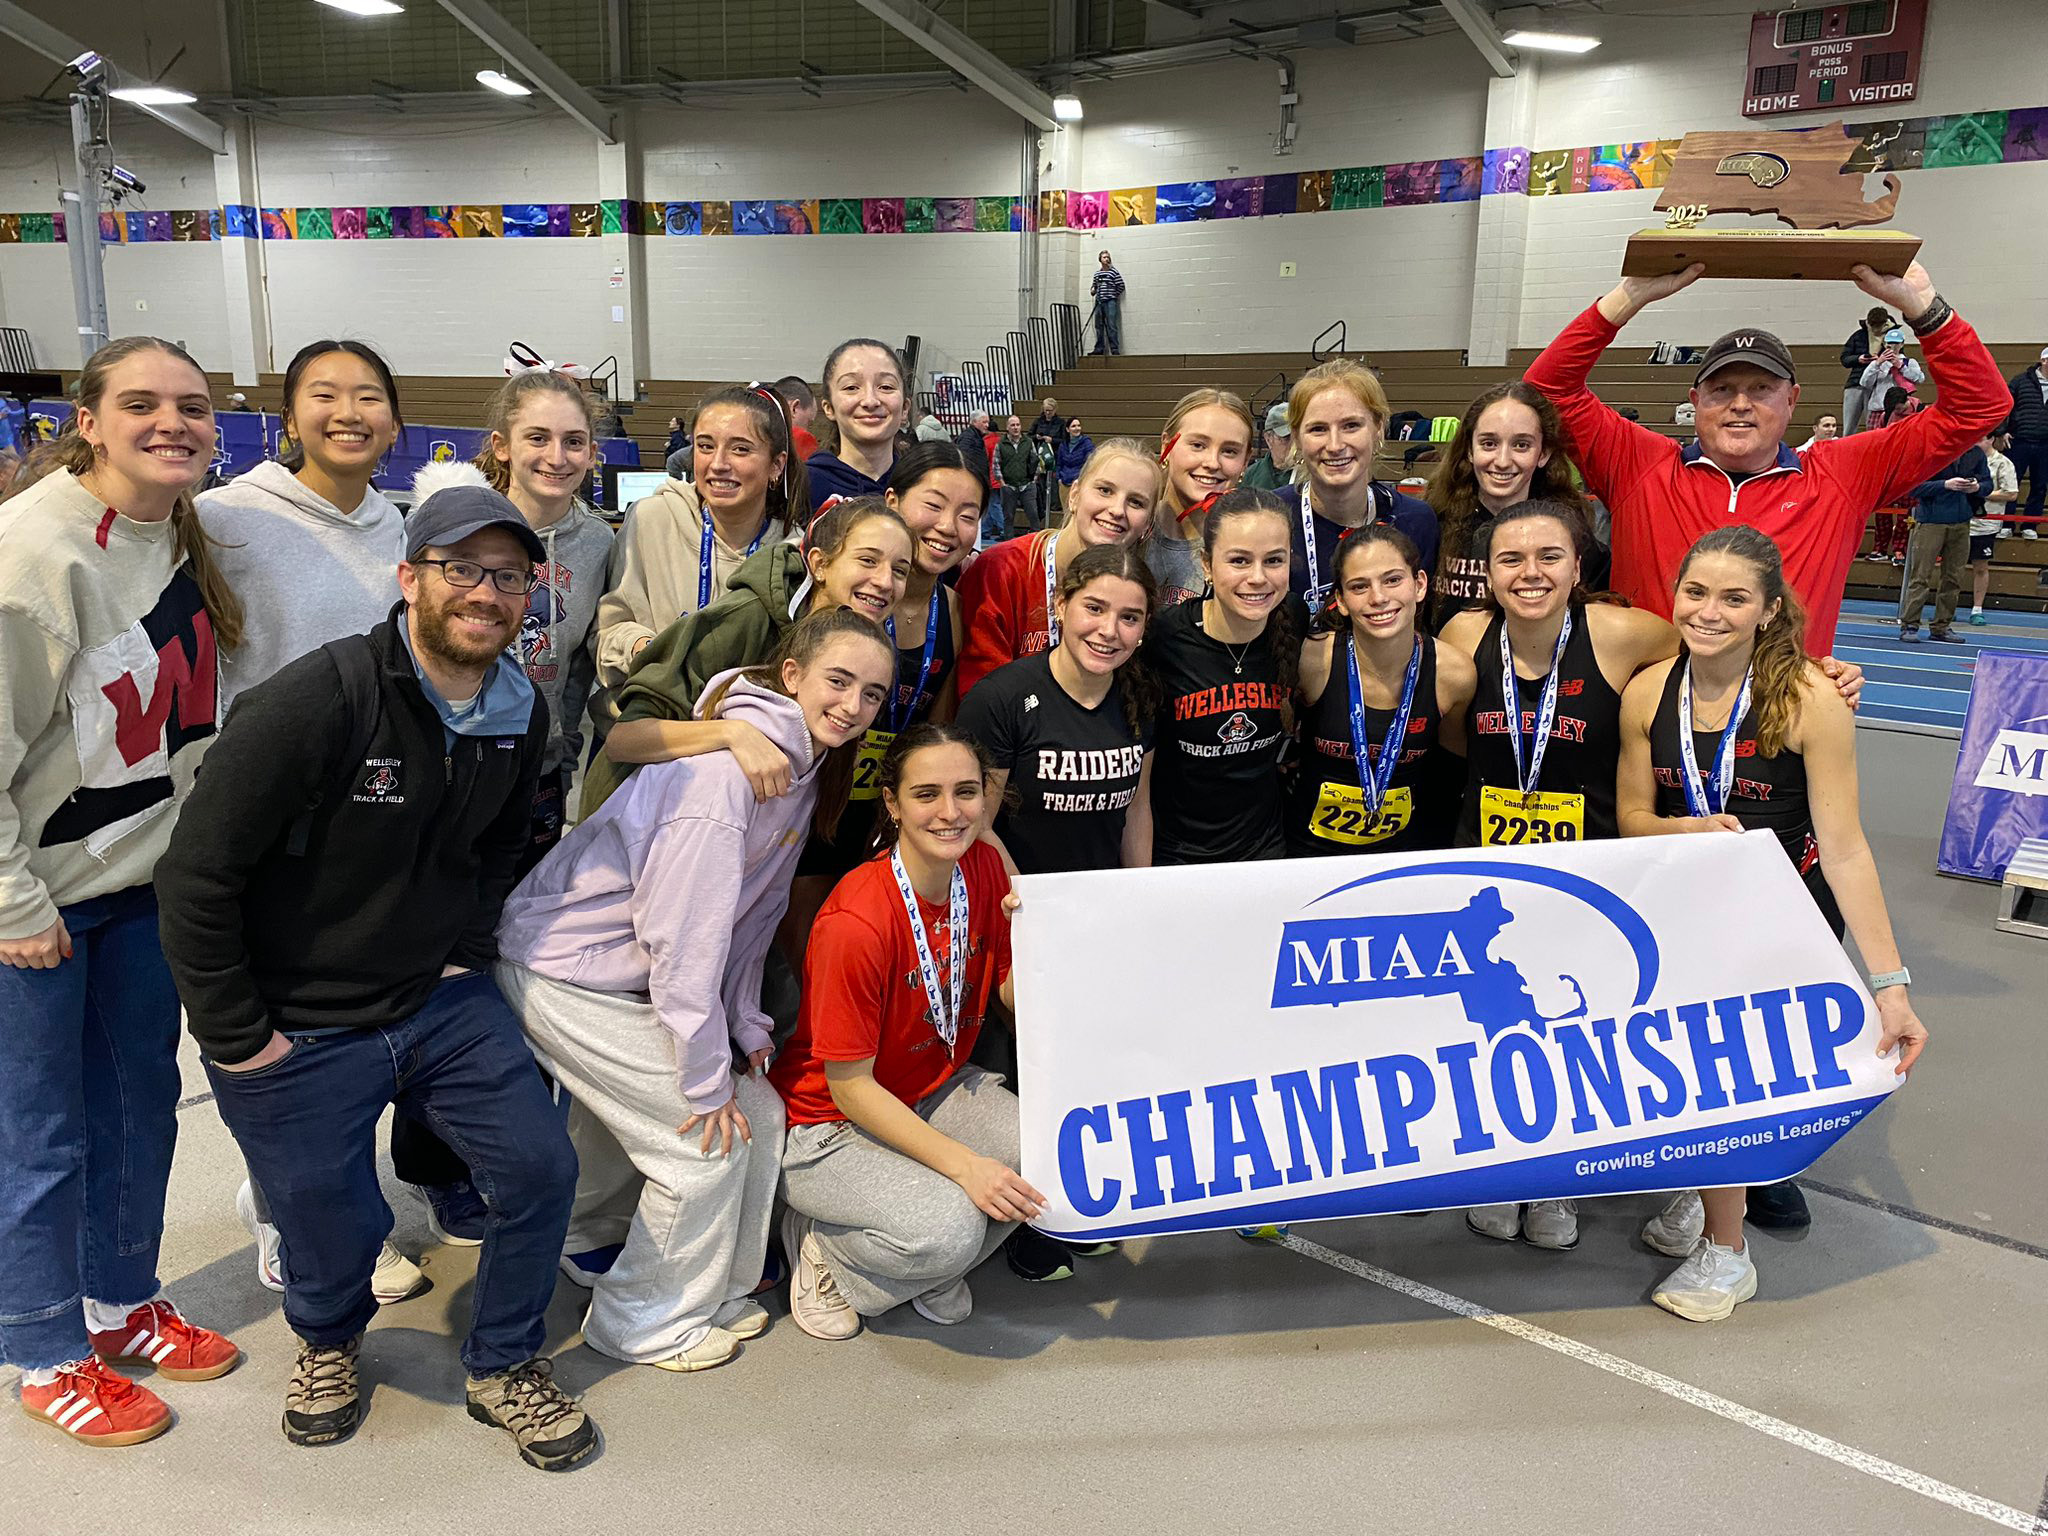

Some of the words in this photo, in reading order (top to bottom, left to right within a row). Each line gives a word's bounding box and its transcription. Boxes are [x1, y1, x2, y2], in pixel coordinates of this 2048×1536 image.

[1811, 43, 1853, 56] BONUS
[1819, 57, 1842, 66] POSS
[1809, 66, 1848, 78] PERIOD
[1849, 83, 1913, 101] VISITOR
[1746, 95, 1800, 113] HOME
[1575, 156, 1584, 184] RUN
[1665, 204, 1709, 223] 2025
[1285, 266, 1290, 275] 7
[1735, 336, 1755, 348] W
[101, 608, 215, 768] W
[1179, 740, 1222, 757] TRACK
[1223, 741, 1250, 755] AND
[366, 758, 402, 767] WELLESLEY
[1037, 744, 1144, 781] RAIDERS
[353, 794, 377, 803] TRACK
[385, 795, 405, 803] FIELD
[1043, 792, 1095, 812] TRACK
[1096, 792, 1107, 811] &
[1488, 813, 1577, 845] 2239
[1288, 930, 1475, 988] MIAA
[1058, 984, 1865, 1216] CHAMPIONSHIP
[1575, 1148, 1656, 1177] Growing
[1660, 1129, 1774, 1163] Courageous
